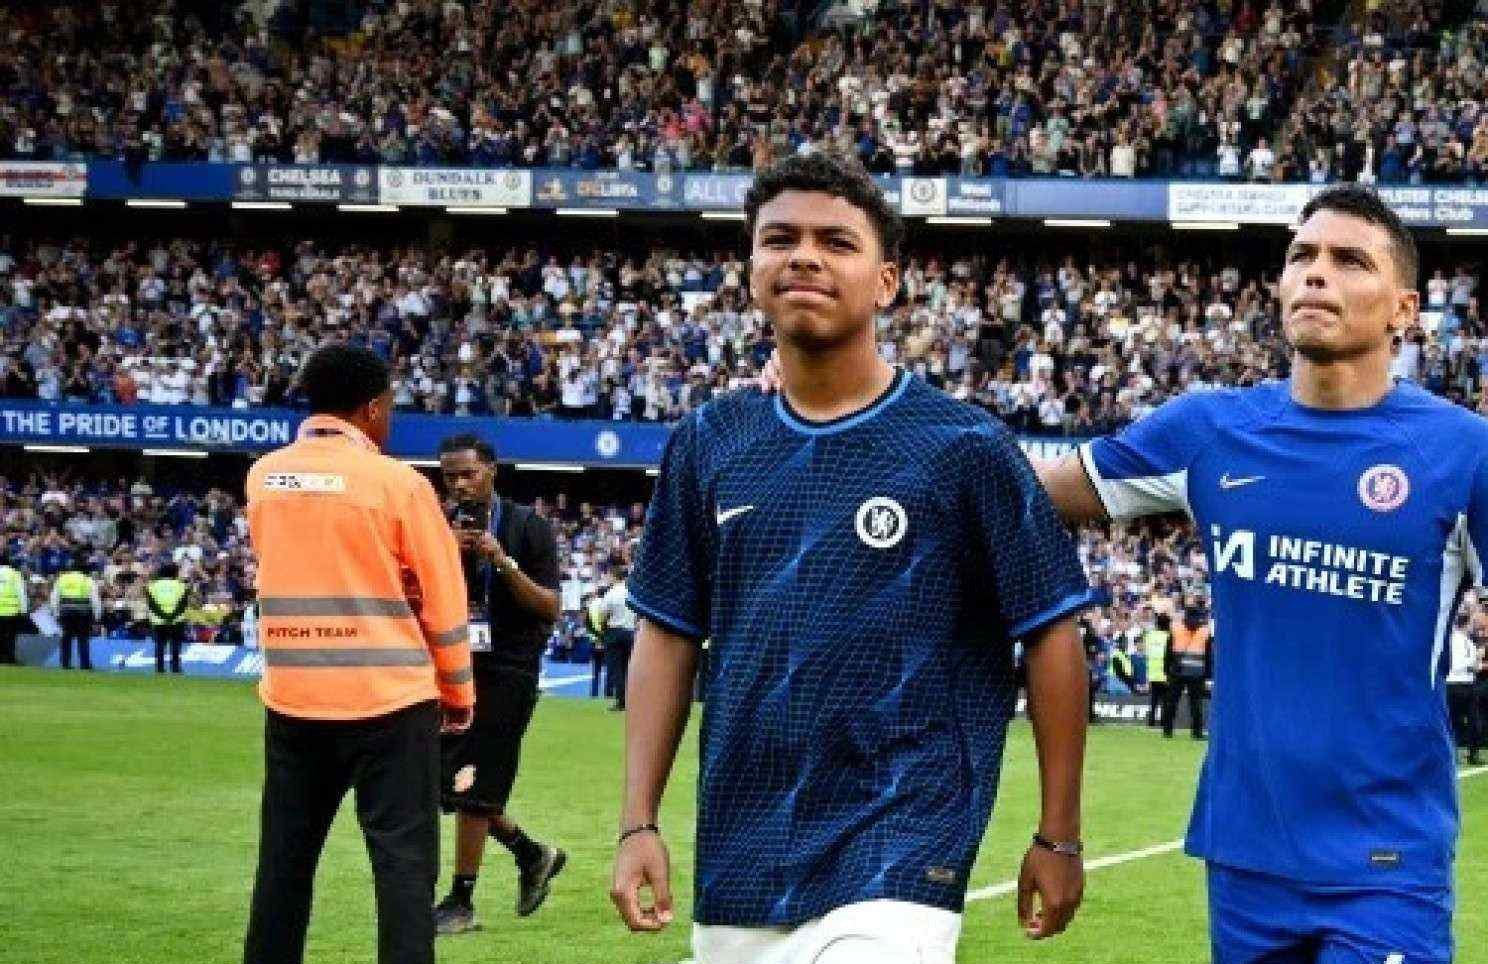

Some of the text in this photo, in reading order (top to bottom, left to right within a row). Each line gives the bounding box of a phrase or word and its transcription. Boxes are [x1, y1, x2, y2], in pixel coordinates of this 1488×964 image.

[2, 409, 290, 443] THE PRIDE OF LONDON
[1268, 535, 1411, 580] INFINITE
[1265, 561, 1407, 605] ATHLETE
[267, 626, 360, 638] PITCH TEAM
